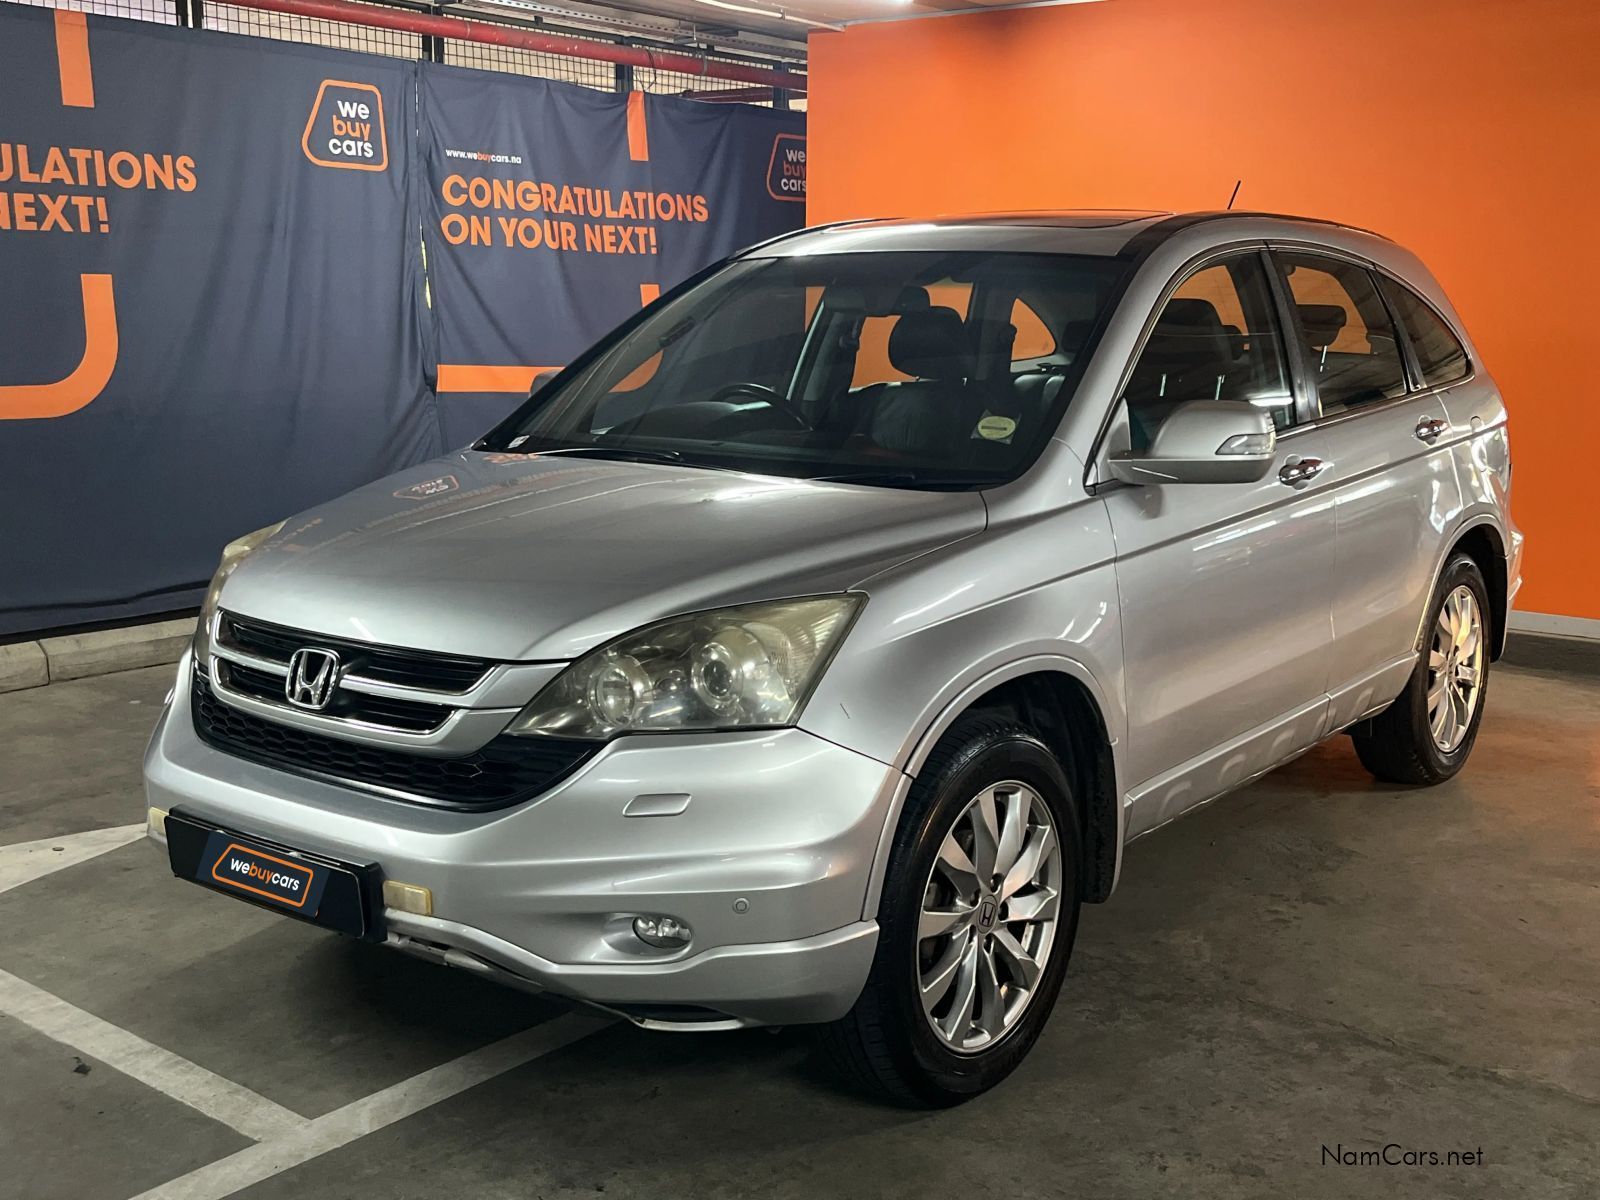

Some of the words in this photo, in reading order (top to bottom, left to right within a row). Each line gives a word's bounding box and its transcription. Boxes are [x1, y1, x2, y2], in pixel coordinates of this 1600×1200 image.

[337, 100, 370, 119] we
[332, 115, 371, 141] buy
[328, 138, 374, 158] cars
[445, 149, 522, 164] www.webuycars.na
[785, 148, 806, 163] we
[441, 174, 709, 222] CONGRATULATIONS
[441, 213, 492, 246] ON
[498, 216, 578, 251] YOUR
[583, 223, 657, 254] NEXT!
[230, 858, 300, 891] webuycars
